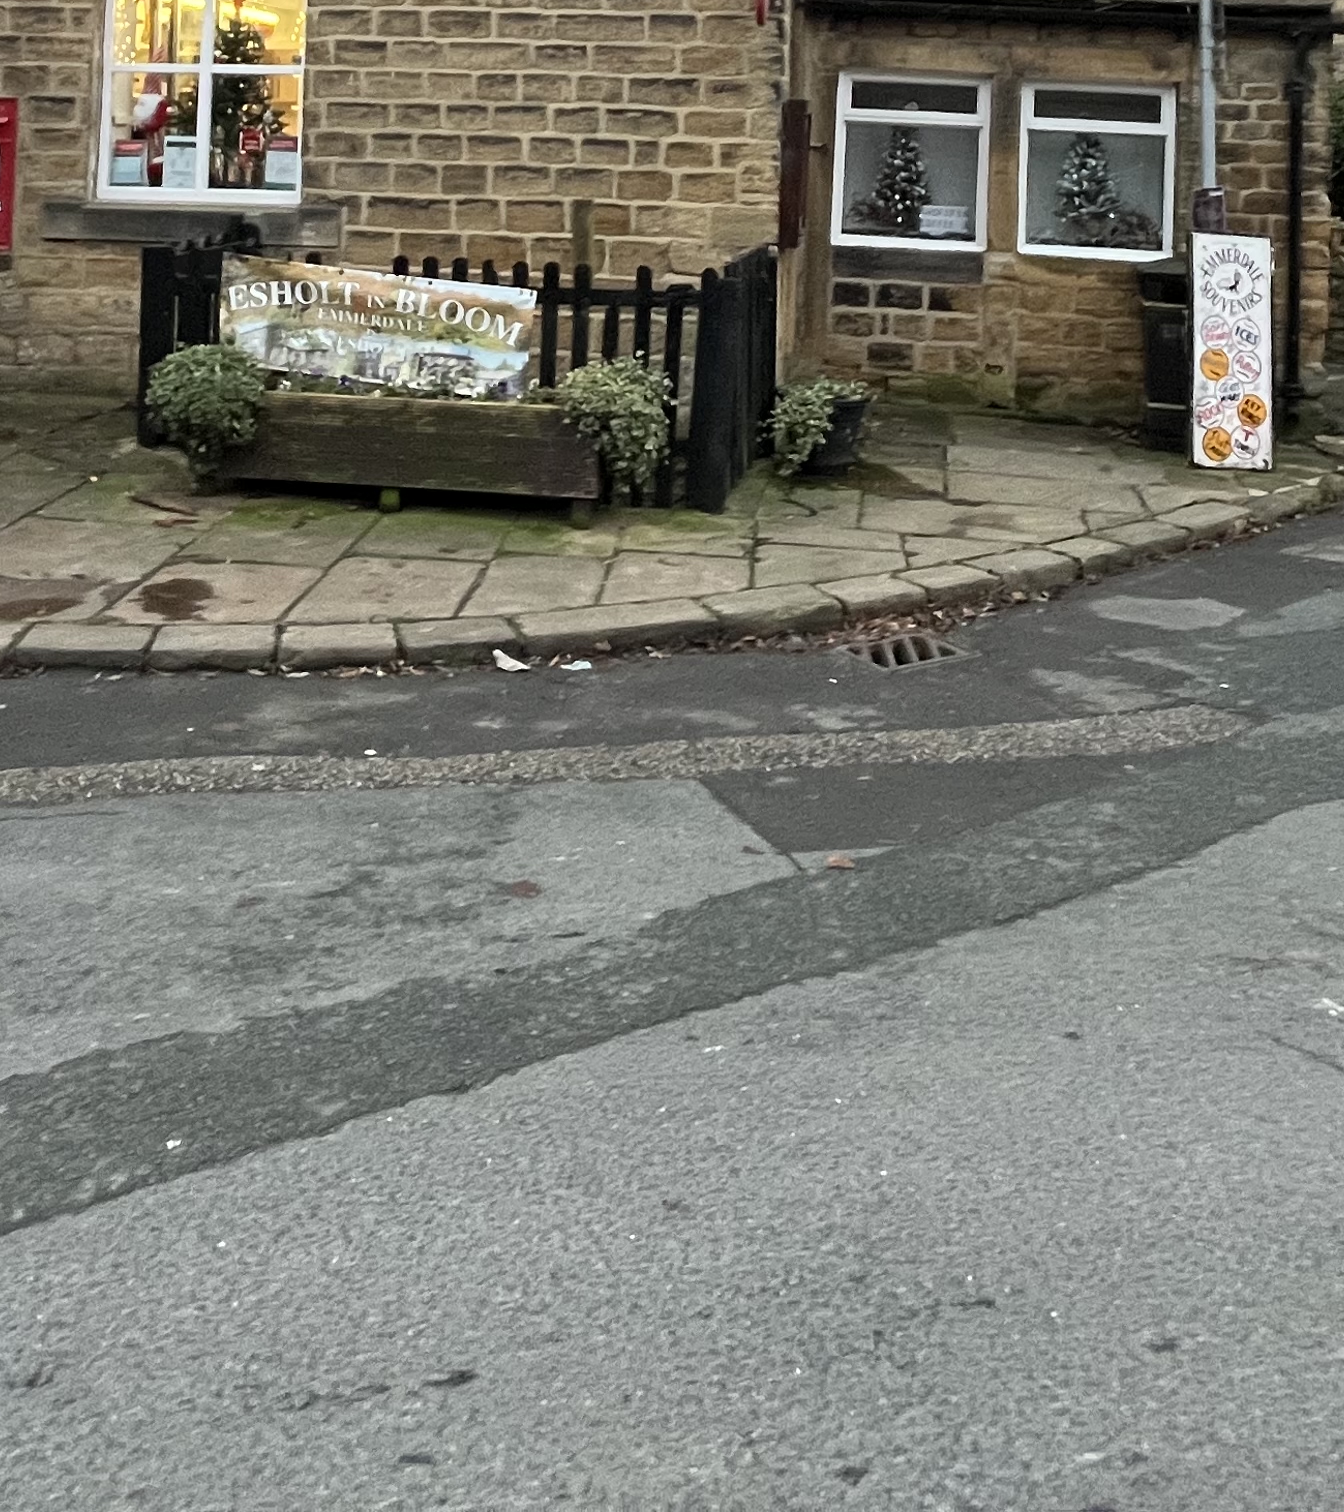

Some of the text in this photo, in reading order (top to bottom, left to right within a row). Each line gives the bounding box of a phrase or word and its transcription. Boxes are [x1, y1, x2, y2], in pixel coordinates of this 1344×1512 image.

[1200, 248, 1265, 280] EMMERDALE
[228, 280, 360, 311] ESHOLT
[367, 294, 385, 309] IN
[395, 288, 524, 347] BLOOM
[1200, 280, 1263, 317] SOUVENIRS
[317, 307, 427, 332] EMMERDALE
[1234, 325, 1260, 345] ICES
